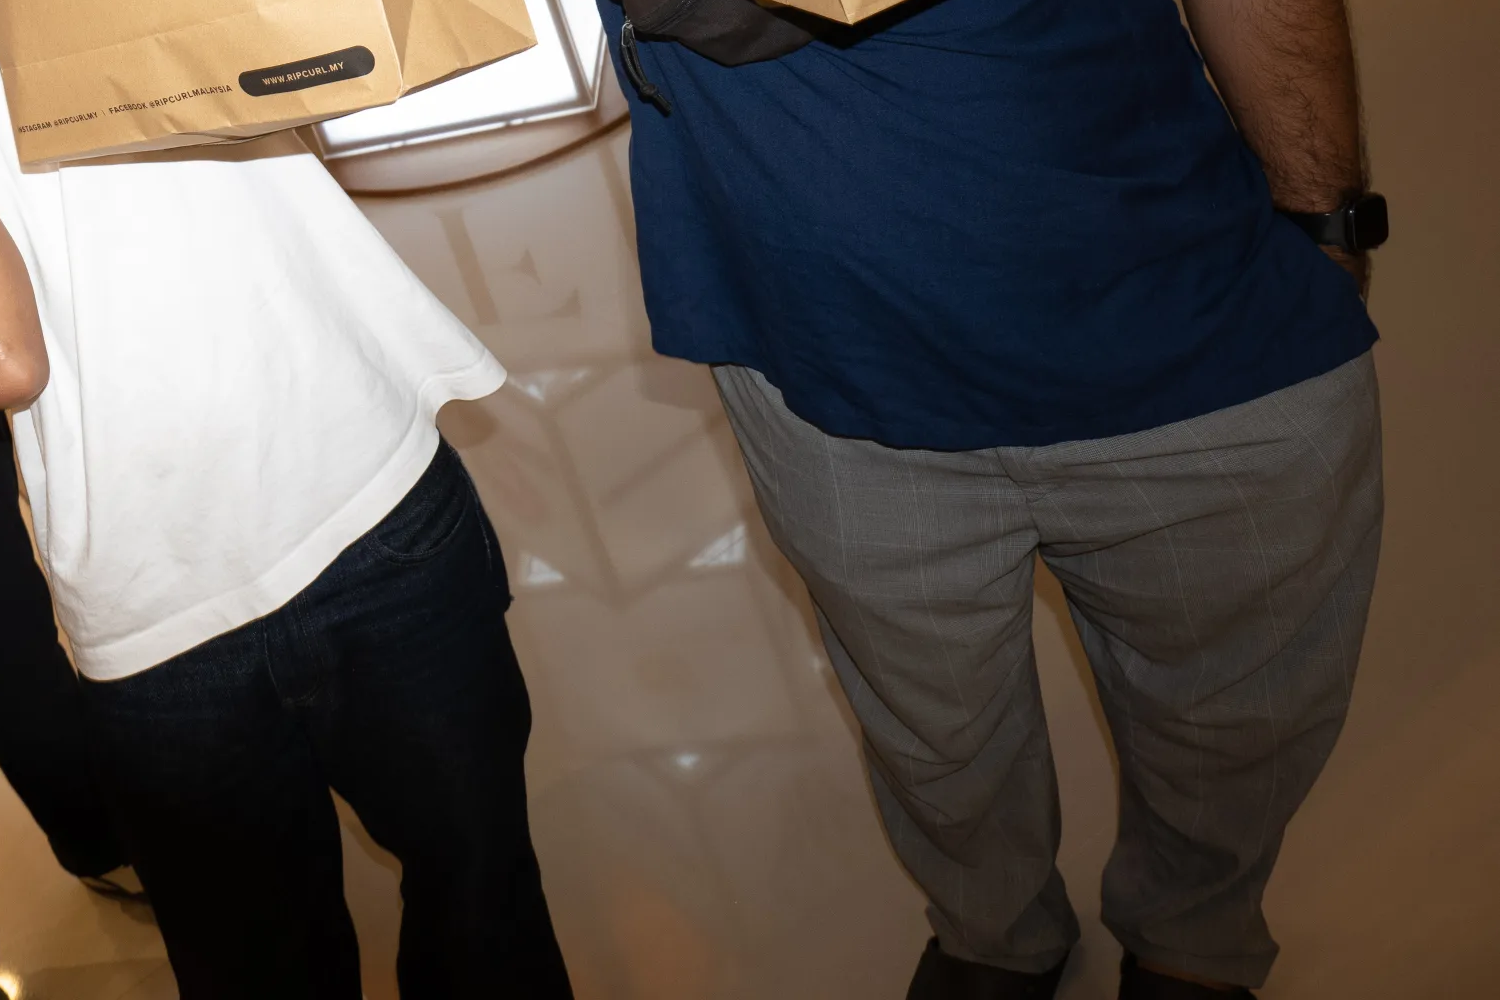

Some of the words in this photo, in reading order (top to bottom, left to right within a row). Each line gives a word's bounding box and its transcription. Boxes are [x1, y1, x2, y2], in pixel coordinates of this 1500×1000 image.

[262, 61, 345, 86] WWW.RIPCURL.MY
[108, 102, 148, 115] FACEBOOK
[149, 84, 233, 109] @RIPCURLMALAYSIA
